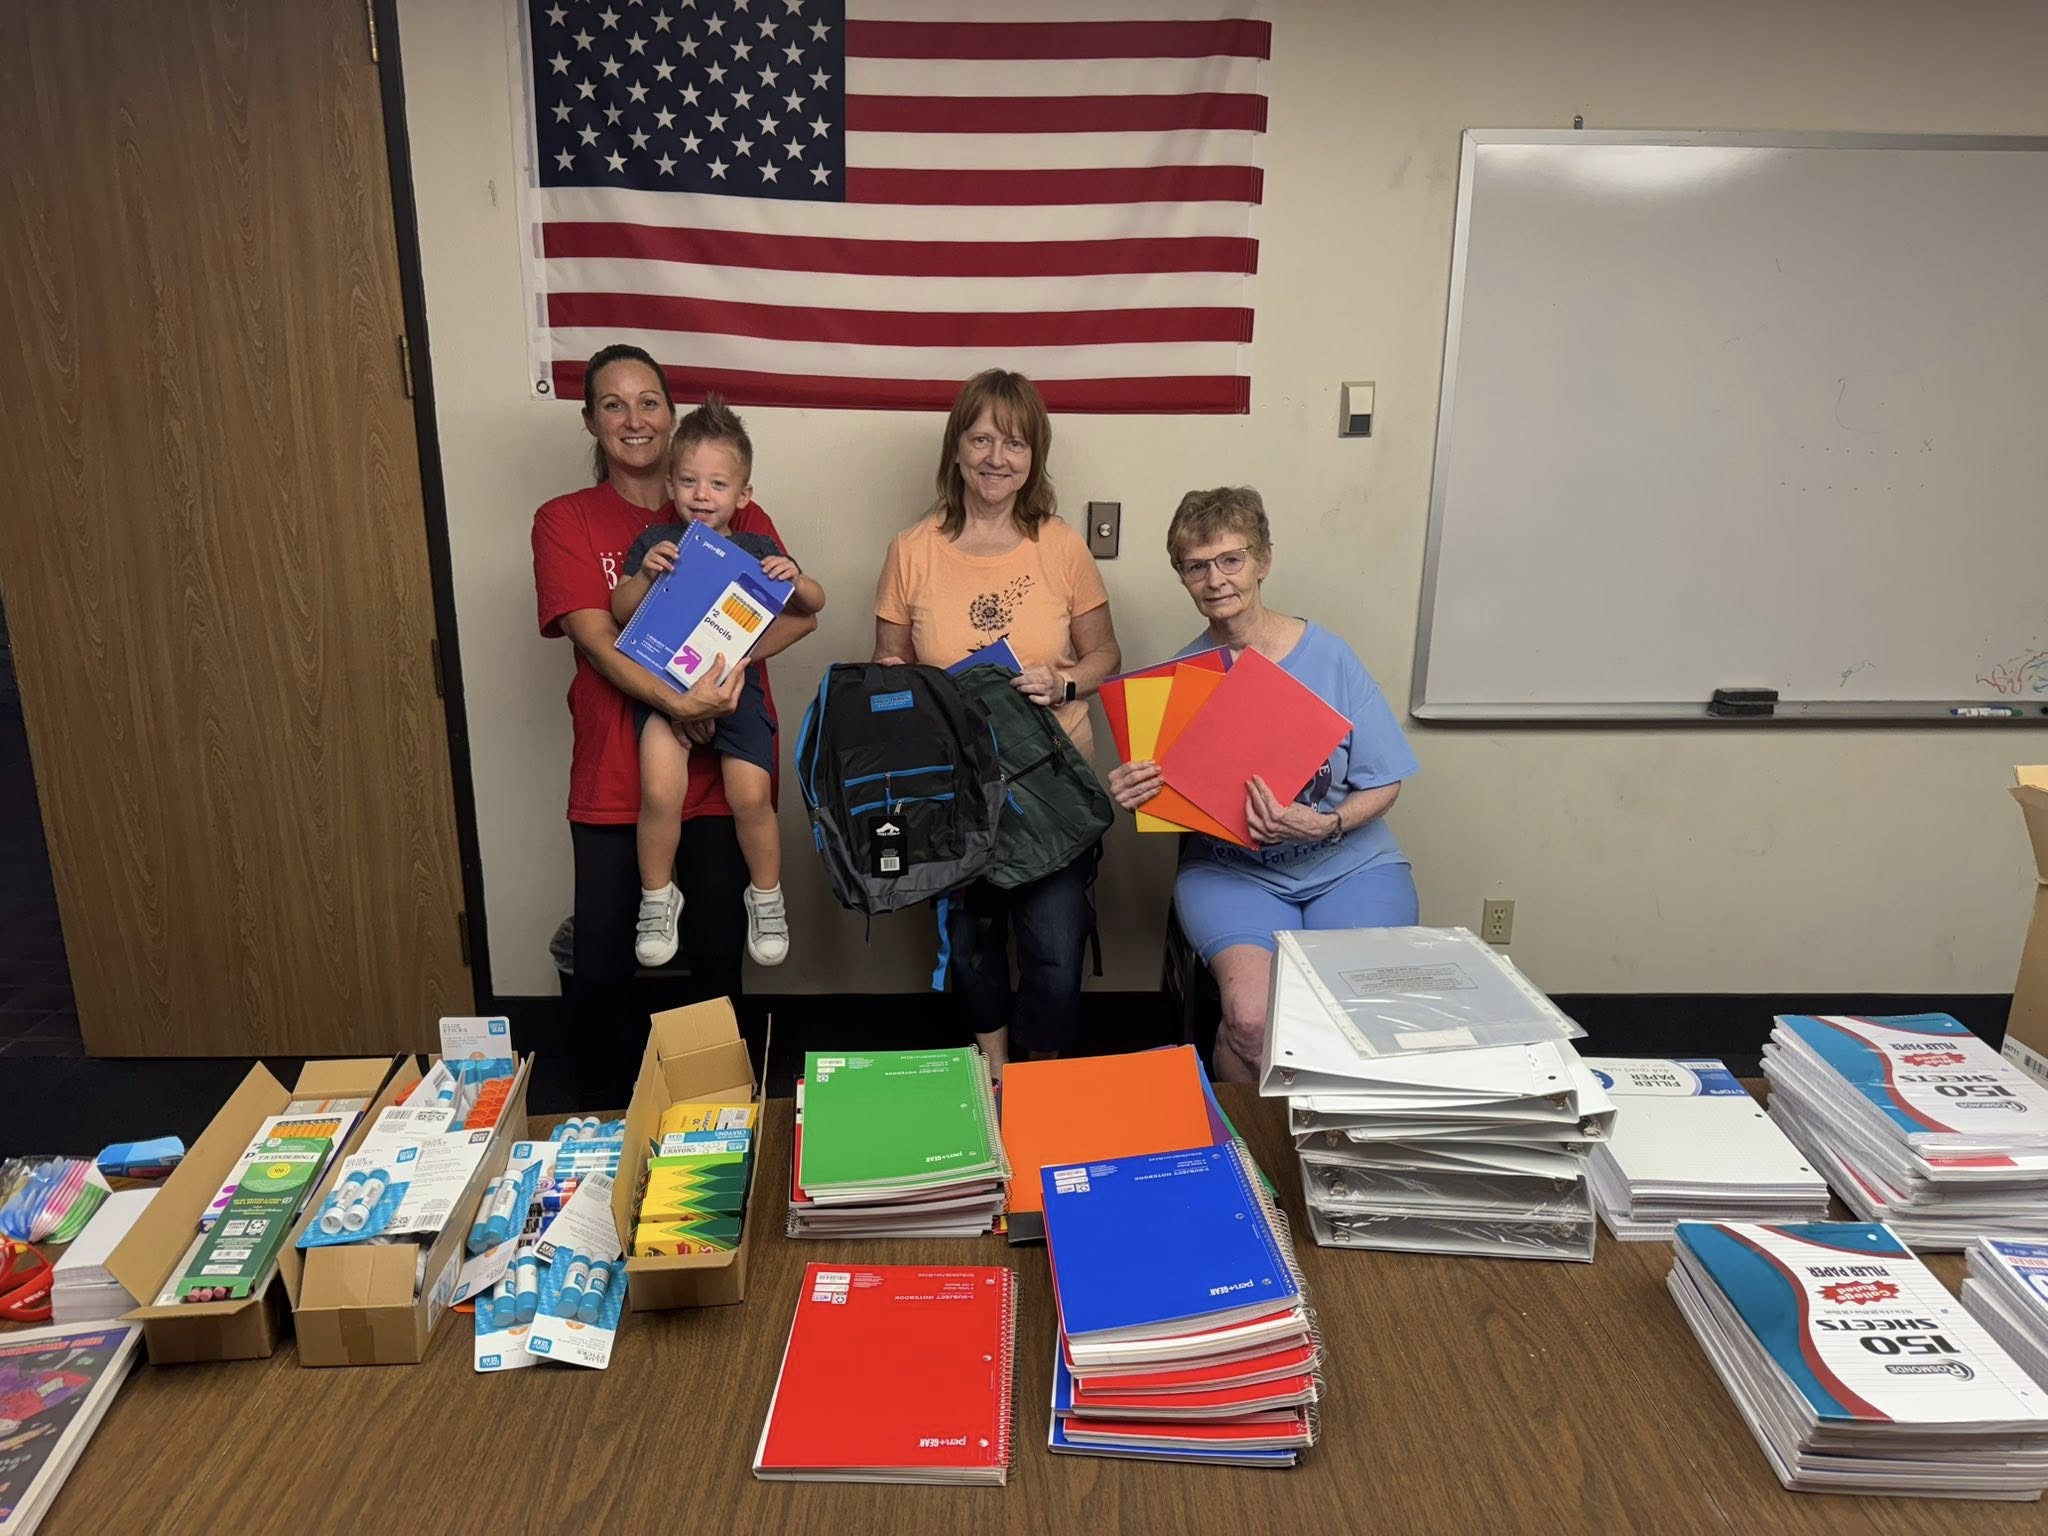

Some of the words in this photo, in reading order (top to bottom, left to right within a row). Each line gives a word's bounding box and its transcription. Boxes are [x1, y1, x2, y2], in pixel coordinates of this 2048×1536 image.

[703, 616, 732, 641] pencils
[1261, 850, 1287, 866] For
[1889, 1042, 1925, 1051] PAPER
[1925, 1042, 1958, 1051] FILLER
[1631, 1073, 1676, 1081] PAPER
[1898, 1074, 1999, 1083] SHEETS
[1634, 1080, 1682, 1088] FILLER
[1934, 1085, 2017, 1098] 150
[663, 1147, 696, 1155] CRAYONS
[1806, 1266, 1851, 1278] PAPER
[1851, 1265, 1891, 1277] FILLER
[1209, 1279, 1254, 1296] pen+GEAR
[1836, 1284, 1878, 1294] Ruled
[1836, 1289, 1892, 1301] College
[1815, 1318, 1940, 1331] SHEETS
[1859, 1335, 1962, 1355] 150
[1887, 1363, 1967, 1377] ROSMONDE
[919, 1435, 967, 1448] pen+GEAR
